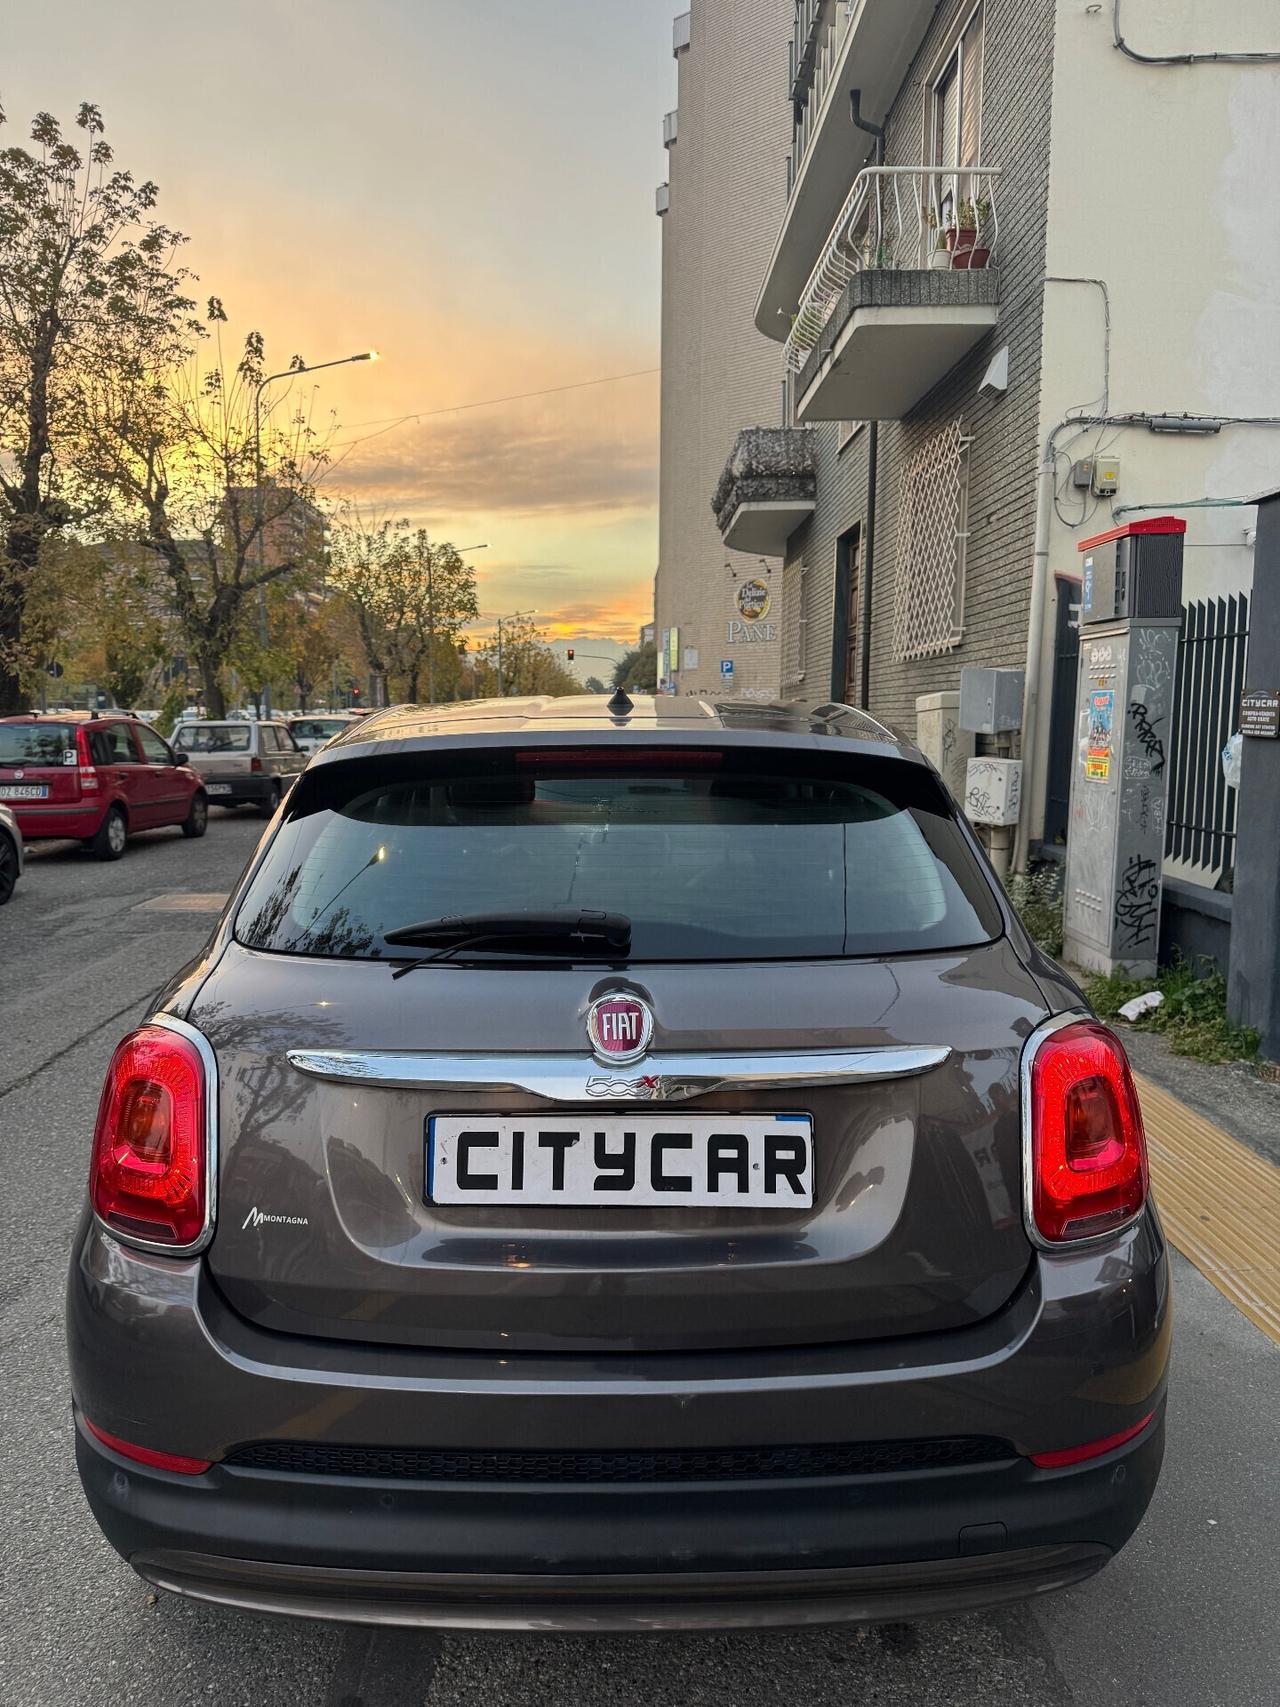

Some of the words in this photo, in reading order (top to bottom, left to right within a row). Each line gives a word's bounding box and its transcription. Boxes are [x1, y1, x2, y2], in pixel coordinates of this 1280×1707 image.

[722, 661, 732, 671] P
[1241, 699, 1279, 708] CITYCAR
[64, 751, 73, 762] P
[602, 1012, 639, 1041] FIAT
[457, 1131, 807, 1195] CITYCAR
